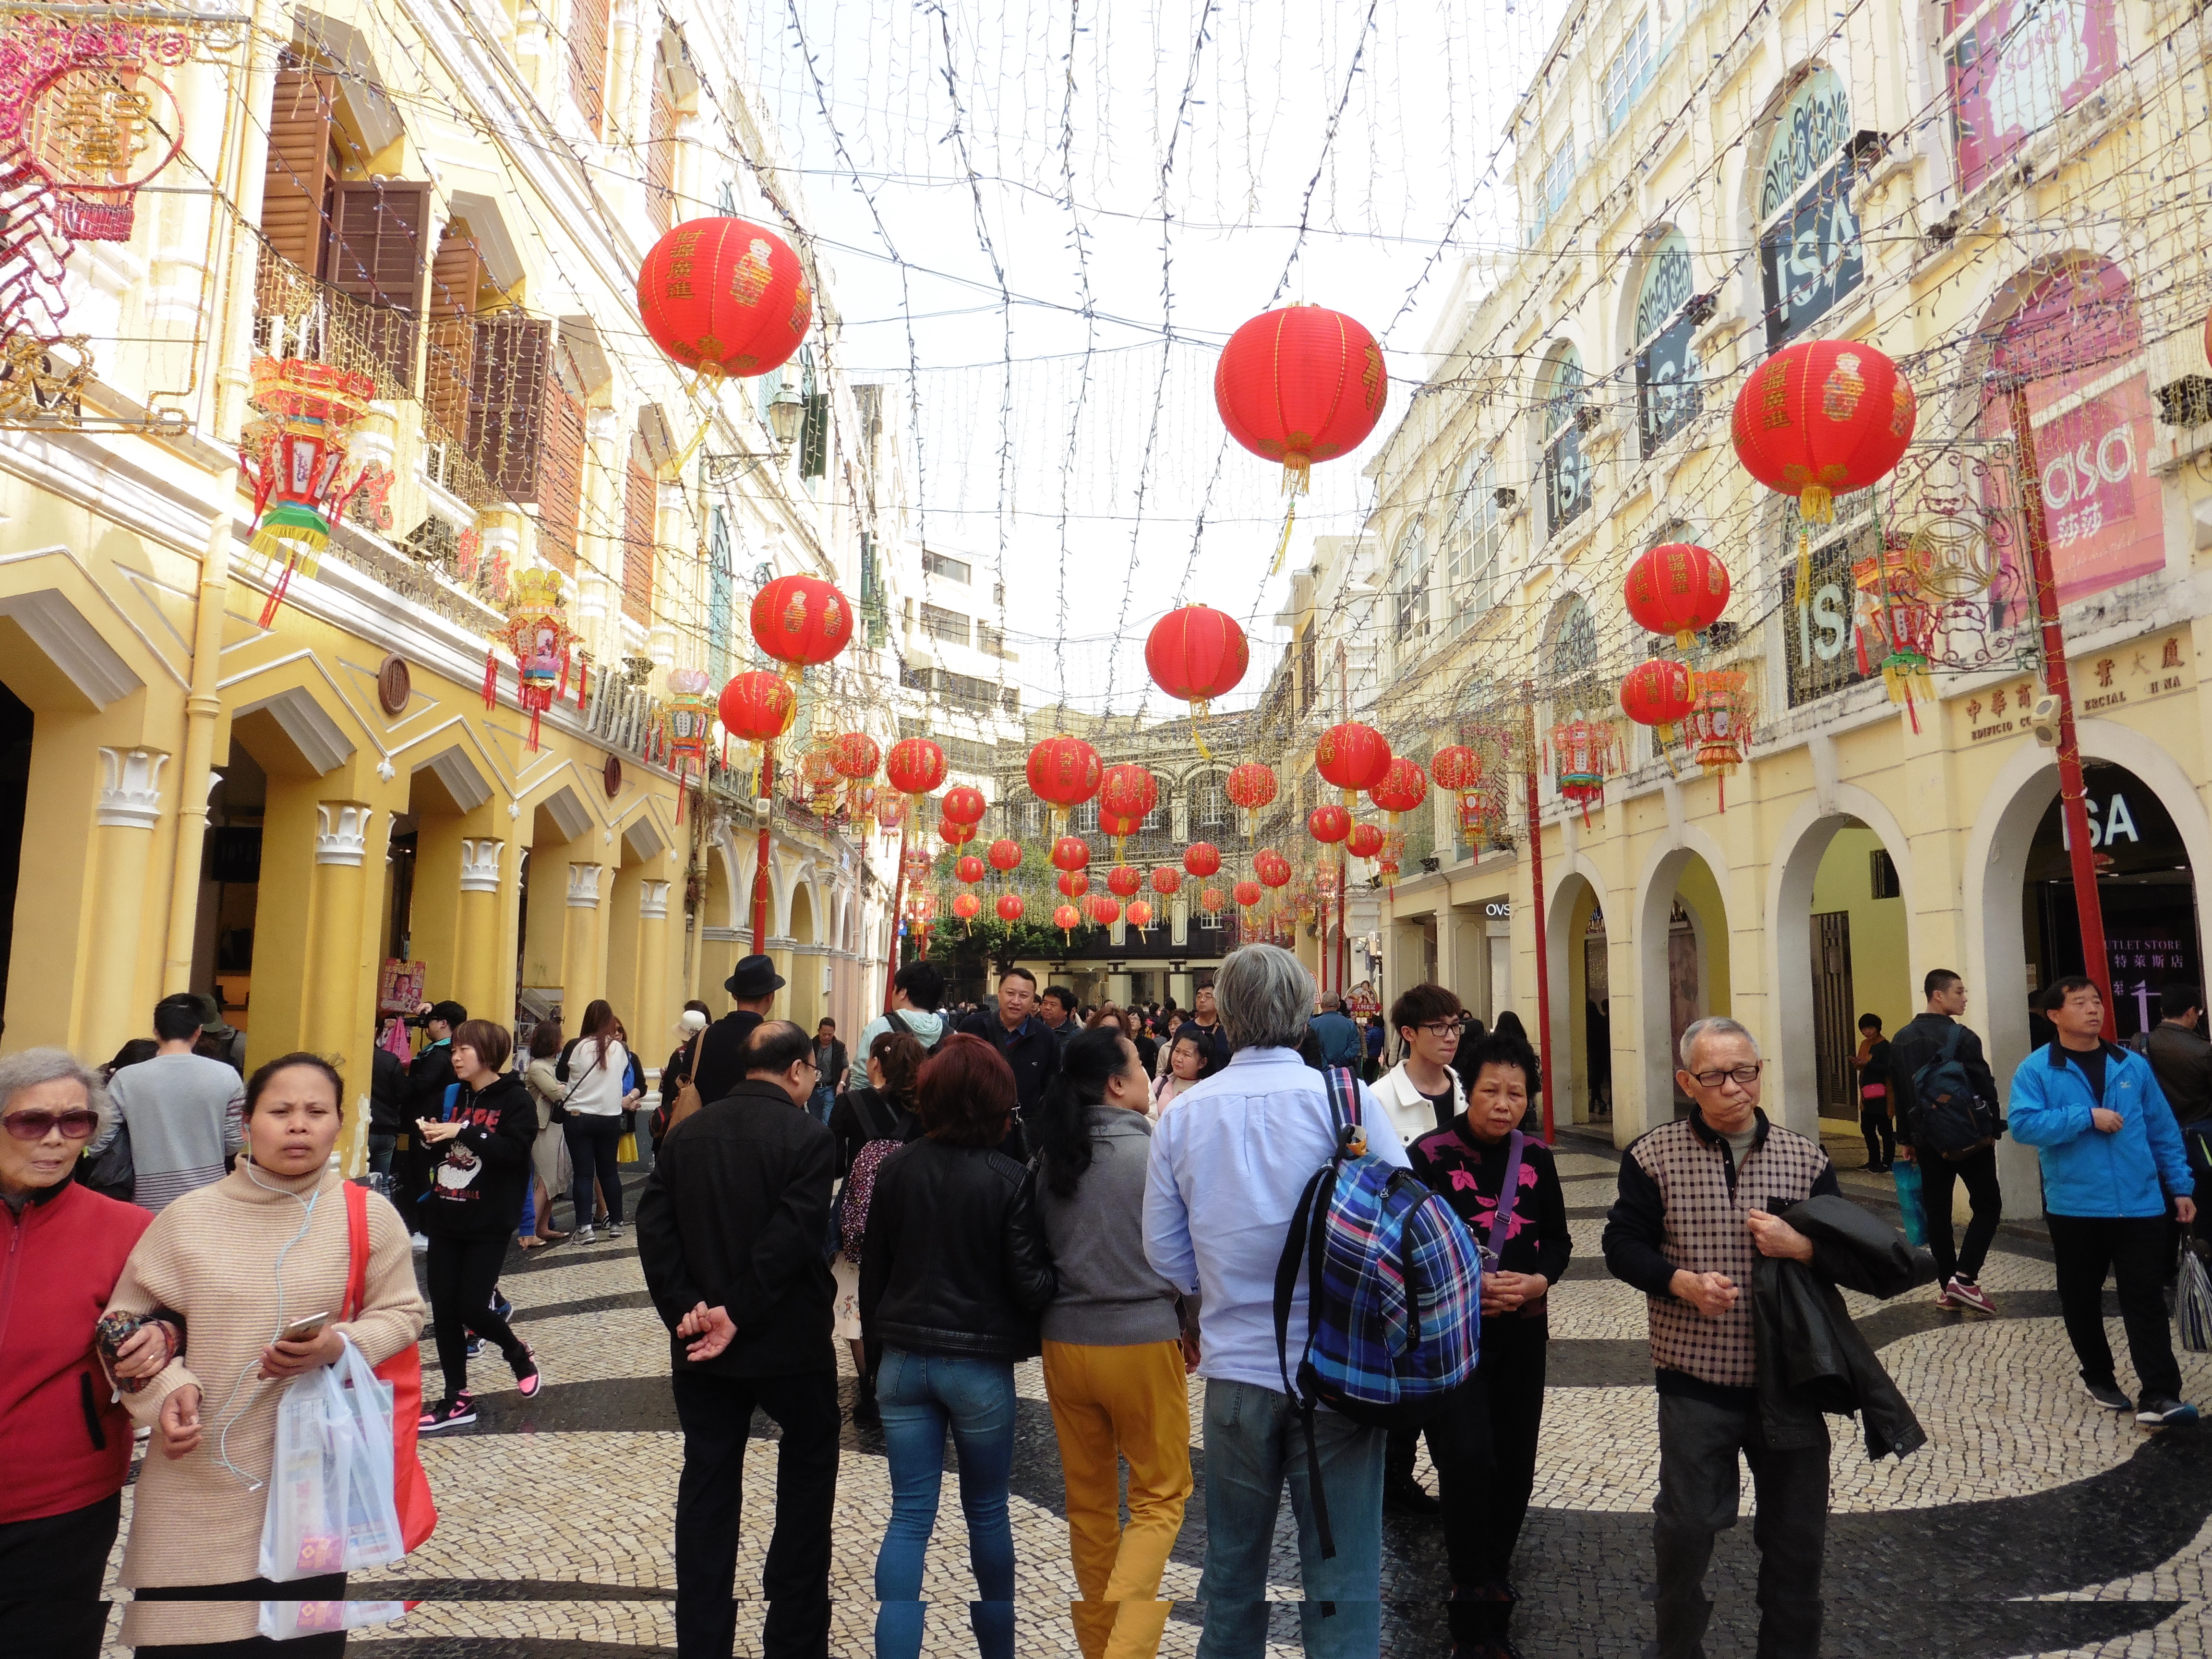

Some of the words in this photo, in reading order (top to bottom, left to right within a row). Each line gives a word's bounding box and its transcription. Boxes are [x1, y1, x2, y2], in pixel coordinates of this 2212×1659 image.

[666, 229, 706, 300] 財源廣進
[1777, 194, 1863, 323] ISA
[2042, 422, 2139, 510] asa
[2057, 502, 2102, 549] 莎莎
[2060, 793, 2140, 851] ISA
[2105, 939, 2141, 950] UTLET
[2144, 939, 2183, 950] STORE
[2114, 953, 2183, 969] 特萊斯店
